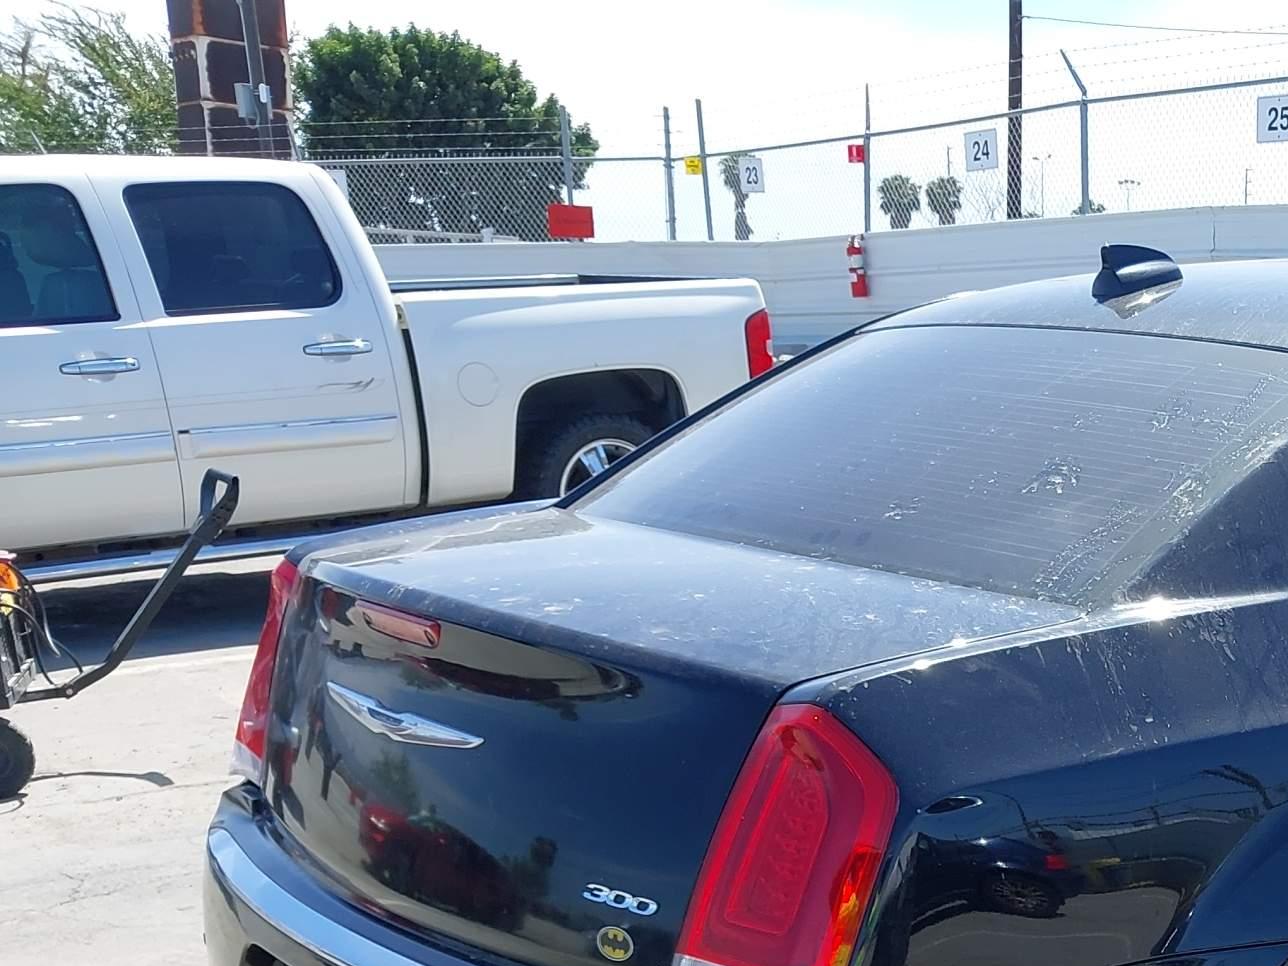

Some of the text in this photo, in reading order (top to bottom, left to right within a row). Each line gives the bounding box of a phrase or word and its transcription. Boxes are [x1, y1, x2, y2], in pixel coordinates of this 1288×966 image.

[972, 139, 990, 161] 24
[745, 166, 759, 185] 23
[583, 884, 658, 916] 300
